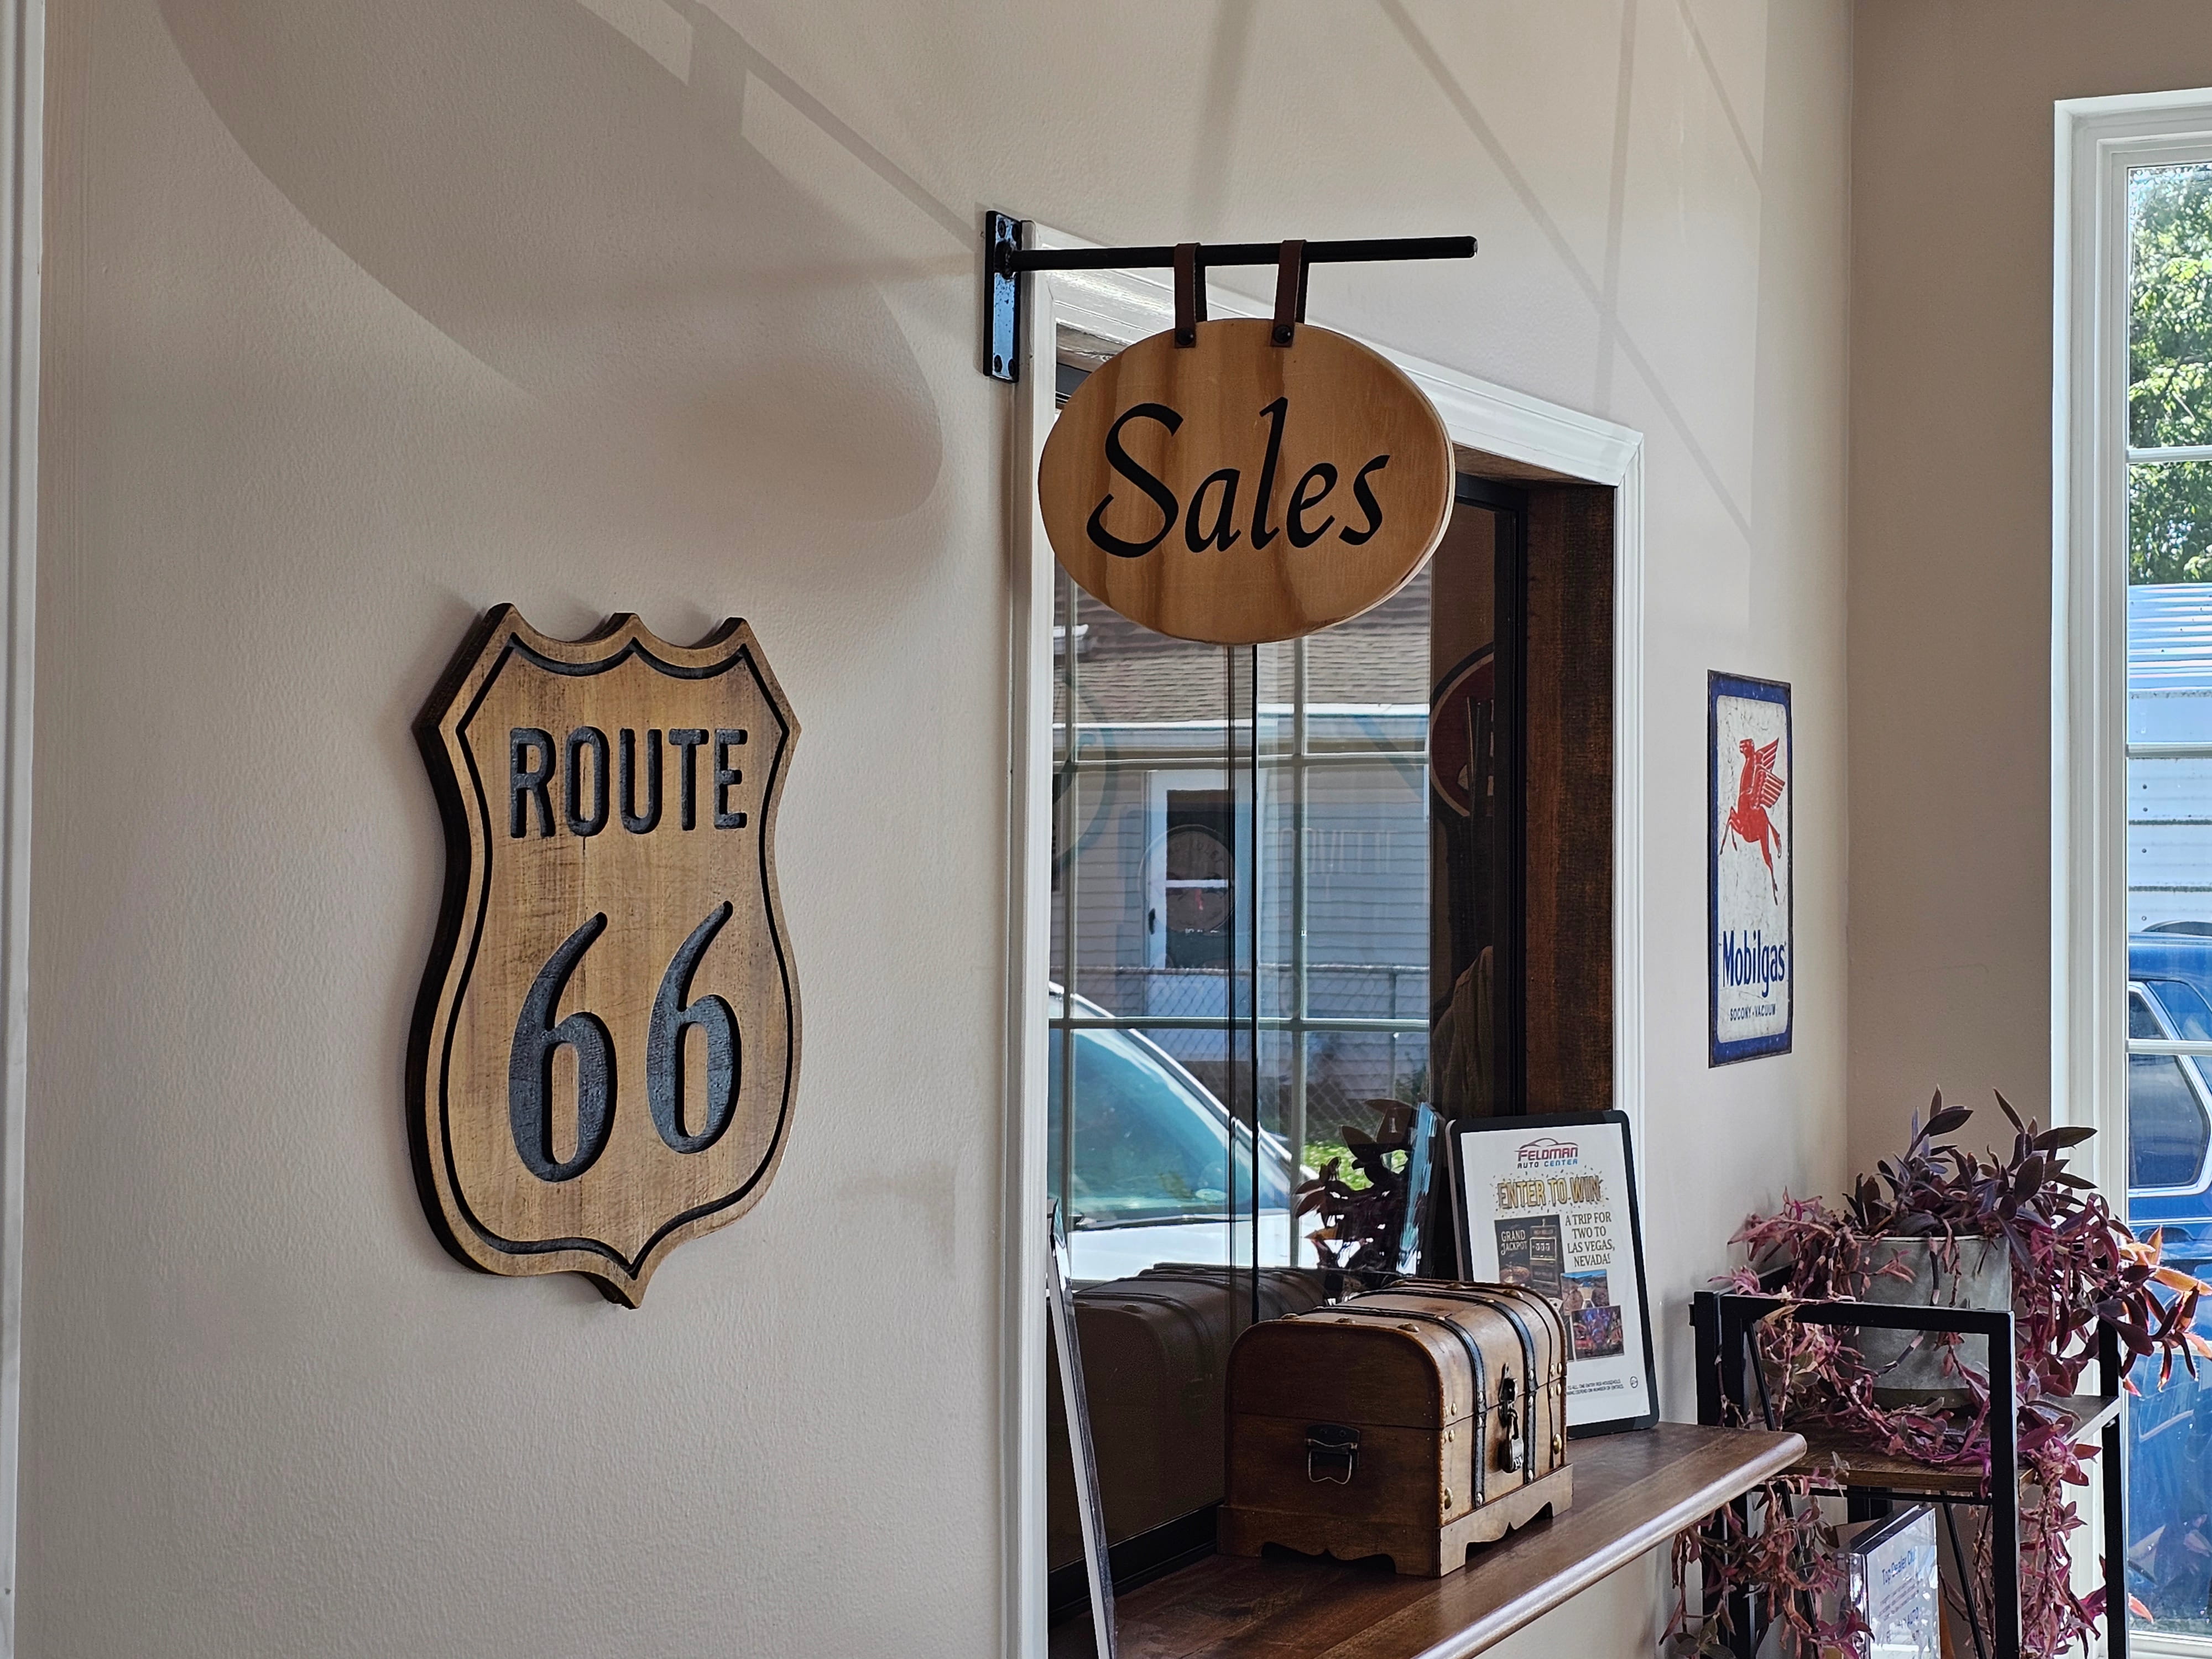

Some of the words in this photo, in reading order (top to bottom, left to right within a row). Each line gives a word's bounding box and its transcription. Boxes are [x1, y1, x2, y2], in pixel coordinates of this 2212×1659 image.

[1086, 397, 1390, 558] Sales
[509, 726, 749, 838] ROUTE
[1723, 930, 1785, 998] Mobilgas
[508, 900, 742, 1182] 66
[1517, 1147, 1578, 1162] FELDMAN
[1544, 1159, 1578, 1167] CENTER
[1498, 1180, 1546, 1209] ENTER
[1547, 1178, 1567, 1207] TO
[1569, 1176, 1601, 1203] WIN
[1565, 1215, 1572, 1226] A
[1572, 1213, 1592, 1225] TRIP
[1594, 1212, 1612, 1223] FOR
[1501, 1229, 1525, 1241] GRAND
[1572, 1227, 1593, 1239] TWO
[1594, 1226, 1606, 1237] TO
[1501, 1241, 1528, 1255] JACKPOT
[1567, 1241, 1583, 1254] LAS
[1584, 1239, 1615, 1251] VEGAS,
[1574, 1253, 1611, 1267] NEVADA!
